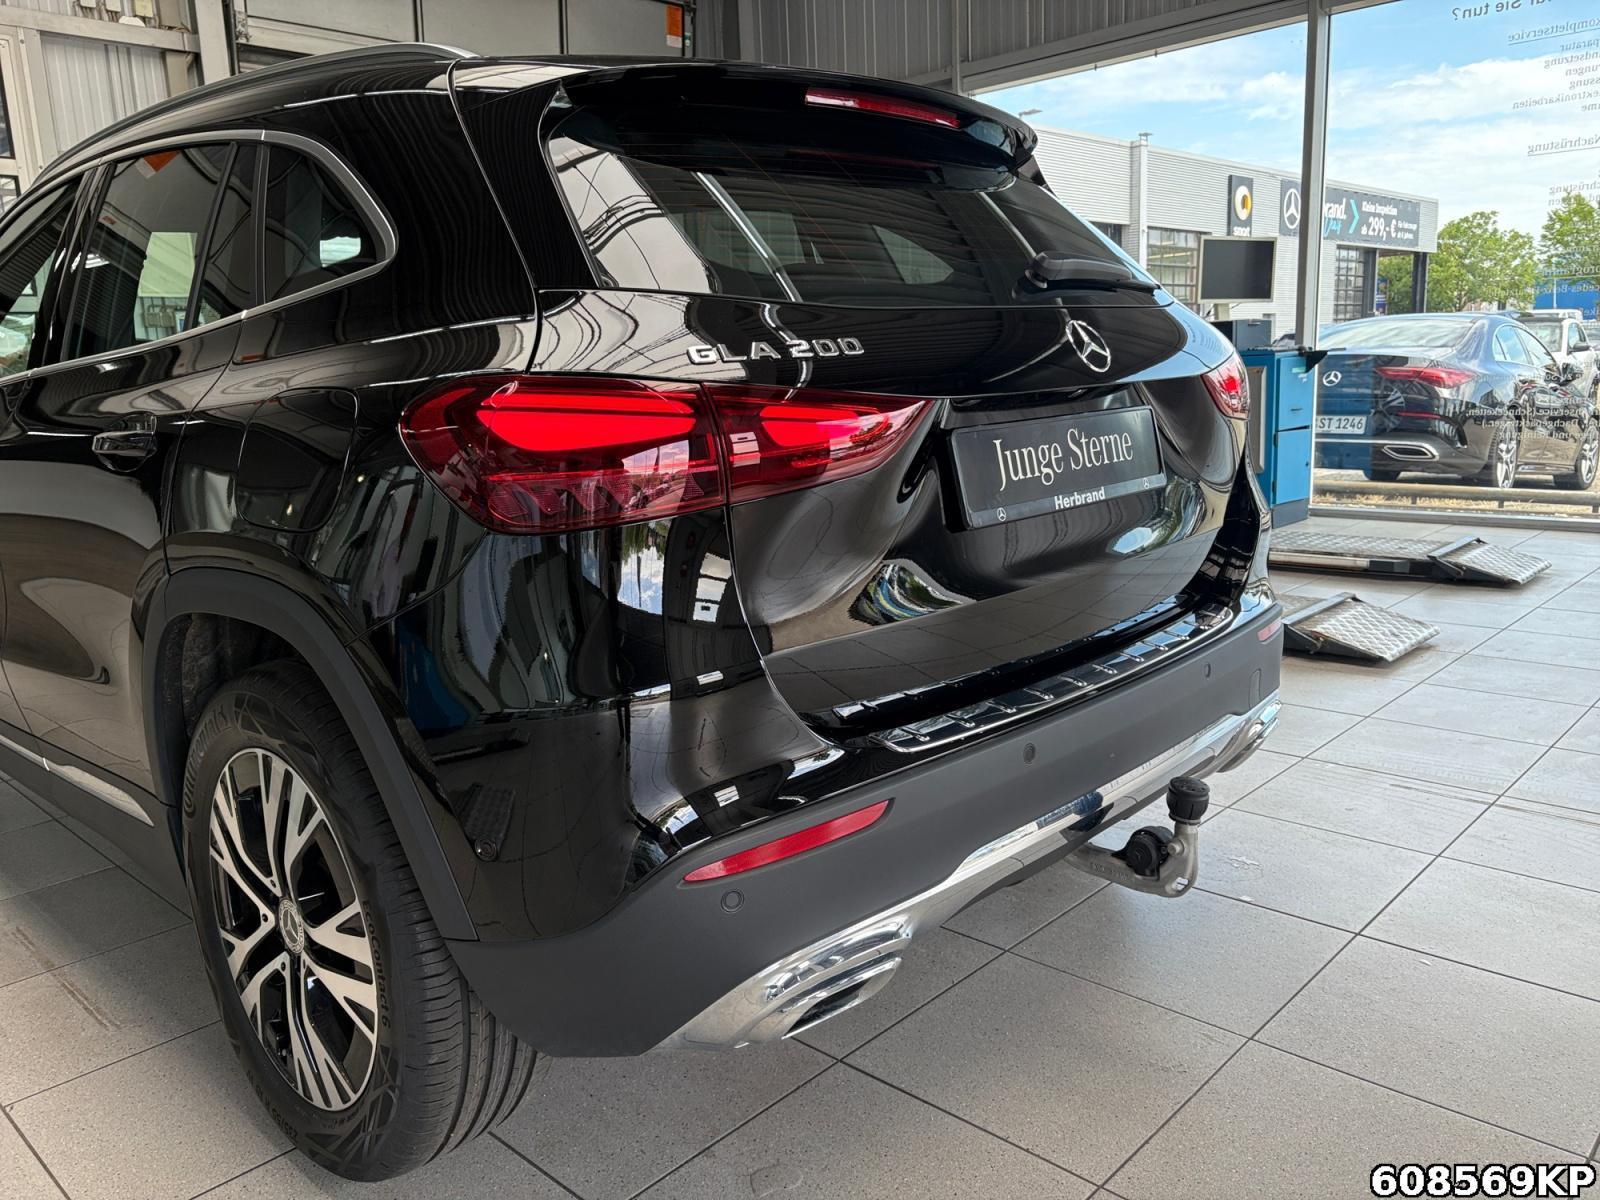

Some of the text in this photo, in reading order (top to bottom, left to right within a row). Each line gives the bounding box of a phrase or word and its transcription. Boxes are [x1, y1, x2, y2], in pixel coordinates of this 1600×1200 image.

[1390, 219, 1398, 239] €
[687, 336, 865, 364] GLA 200
[1335, 417, 1363, 430] 1246
[992, 427, 1134, 492] Junge Sterne
[1054, 487, 1106, 511] Herbrand
